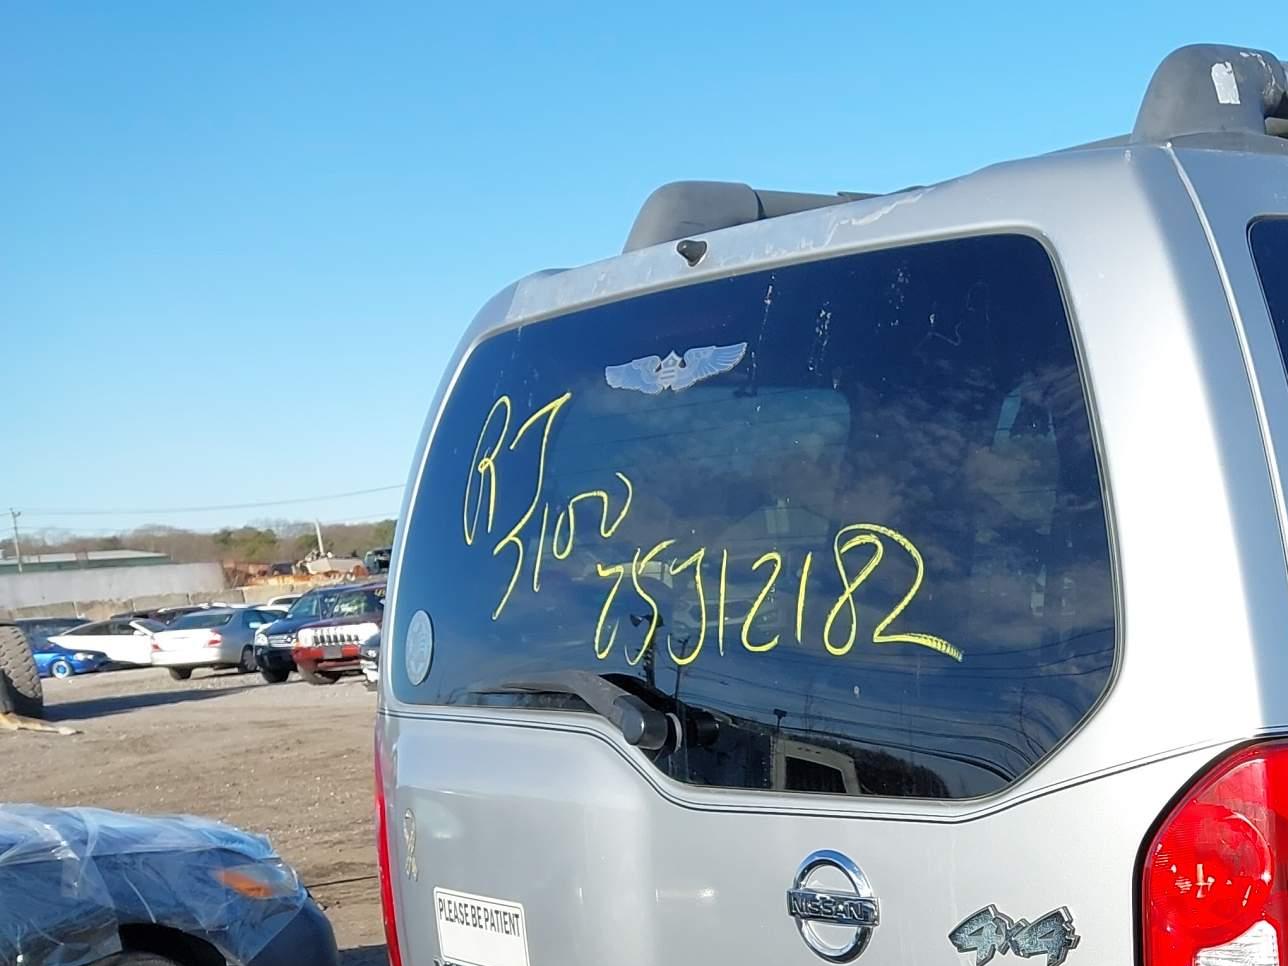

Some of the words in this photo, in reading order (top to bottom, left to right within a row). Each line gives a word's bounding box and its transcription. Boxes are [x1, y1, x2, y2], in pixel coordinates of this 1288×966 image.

[438, 897, 470, 926] PLEASE
[470, 904, 484, 929] BE
[483, 907, 520, 937] PATIENT
[791, 896, 865, 921] NISSAN
